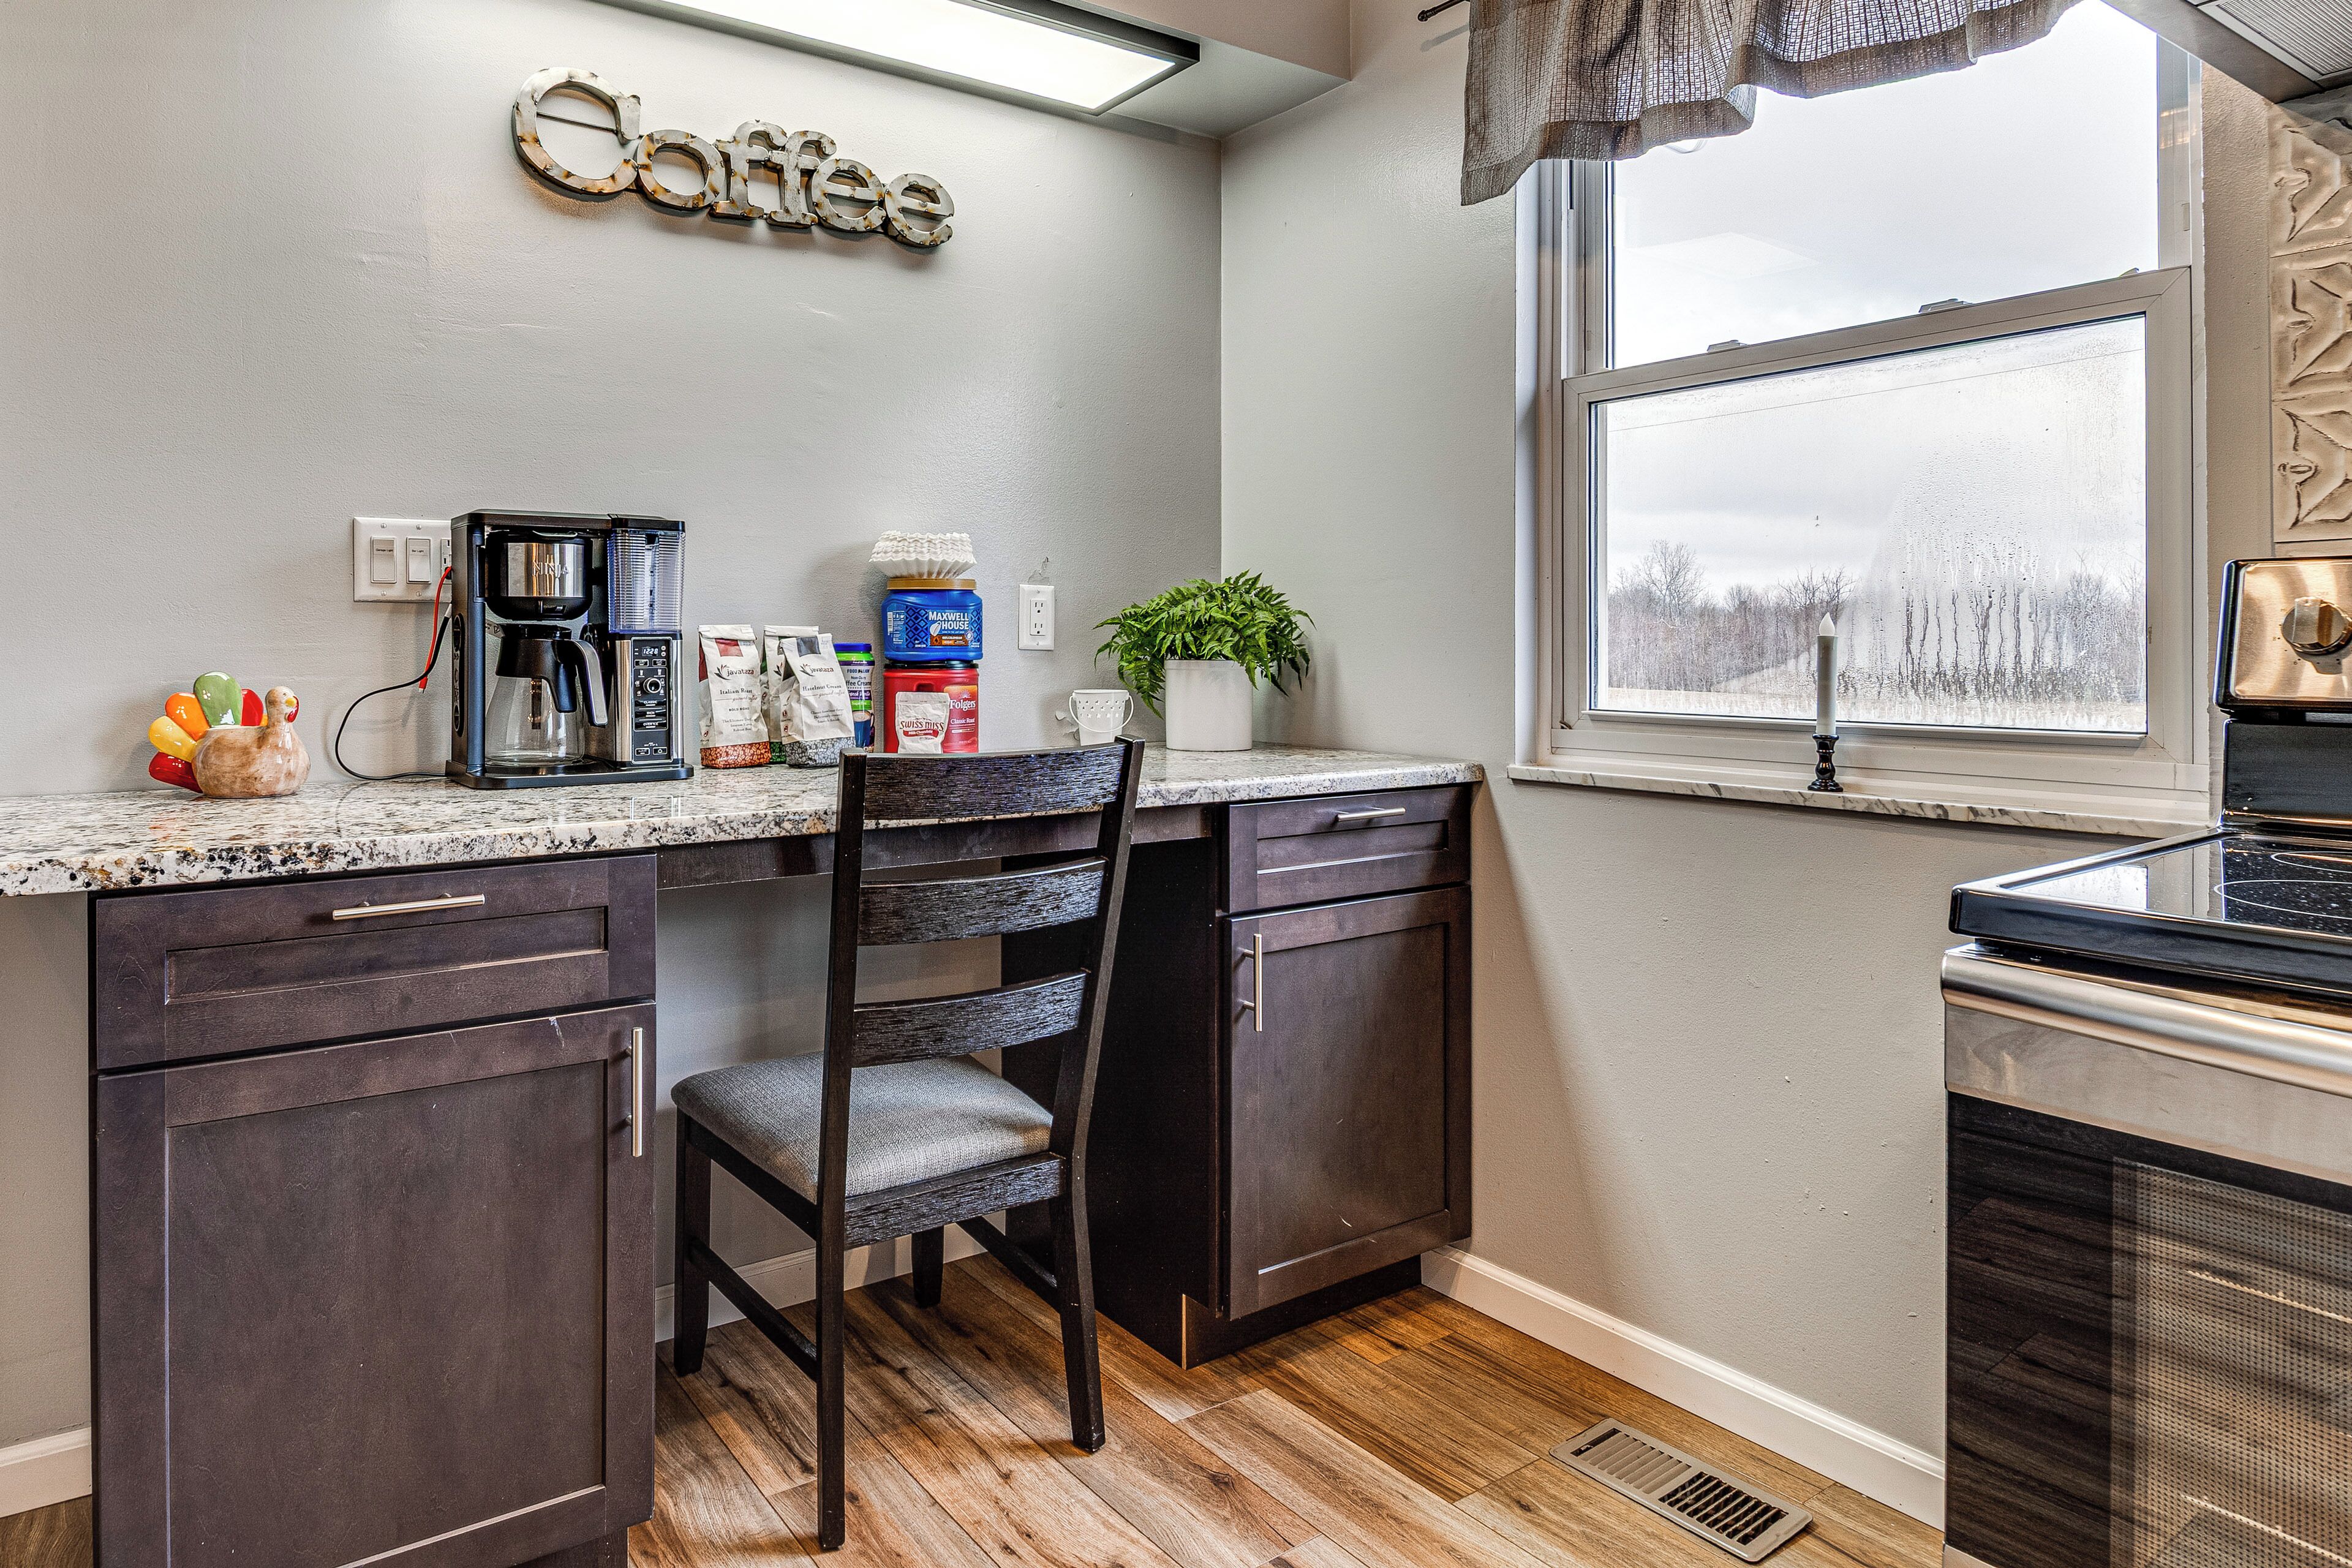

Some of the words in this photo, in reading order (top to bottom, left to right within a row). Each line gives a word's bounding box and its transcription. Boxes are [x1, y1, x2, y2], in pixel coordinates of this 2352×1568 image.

[512, 66, 955, 248] Coffee
[532, 554, 569, 578] NINJA
[929, 611, 969, 620] MAXWELL
[941, 621, 969, 630] HOUSE
[727, 668, 754, 677] javataza
[950, 699, 976, 711] Folgers
[900, 720, 923, 729] SWISS
